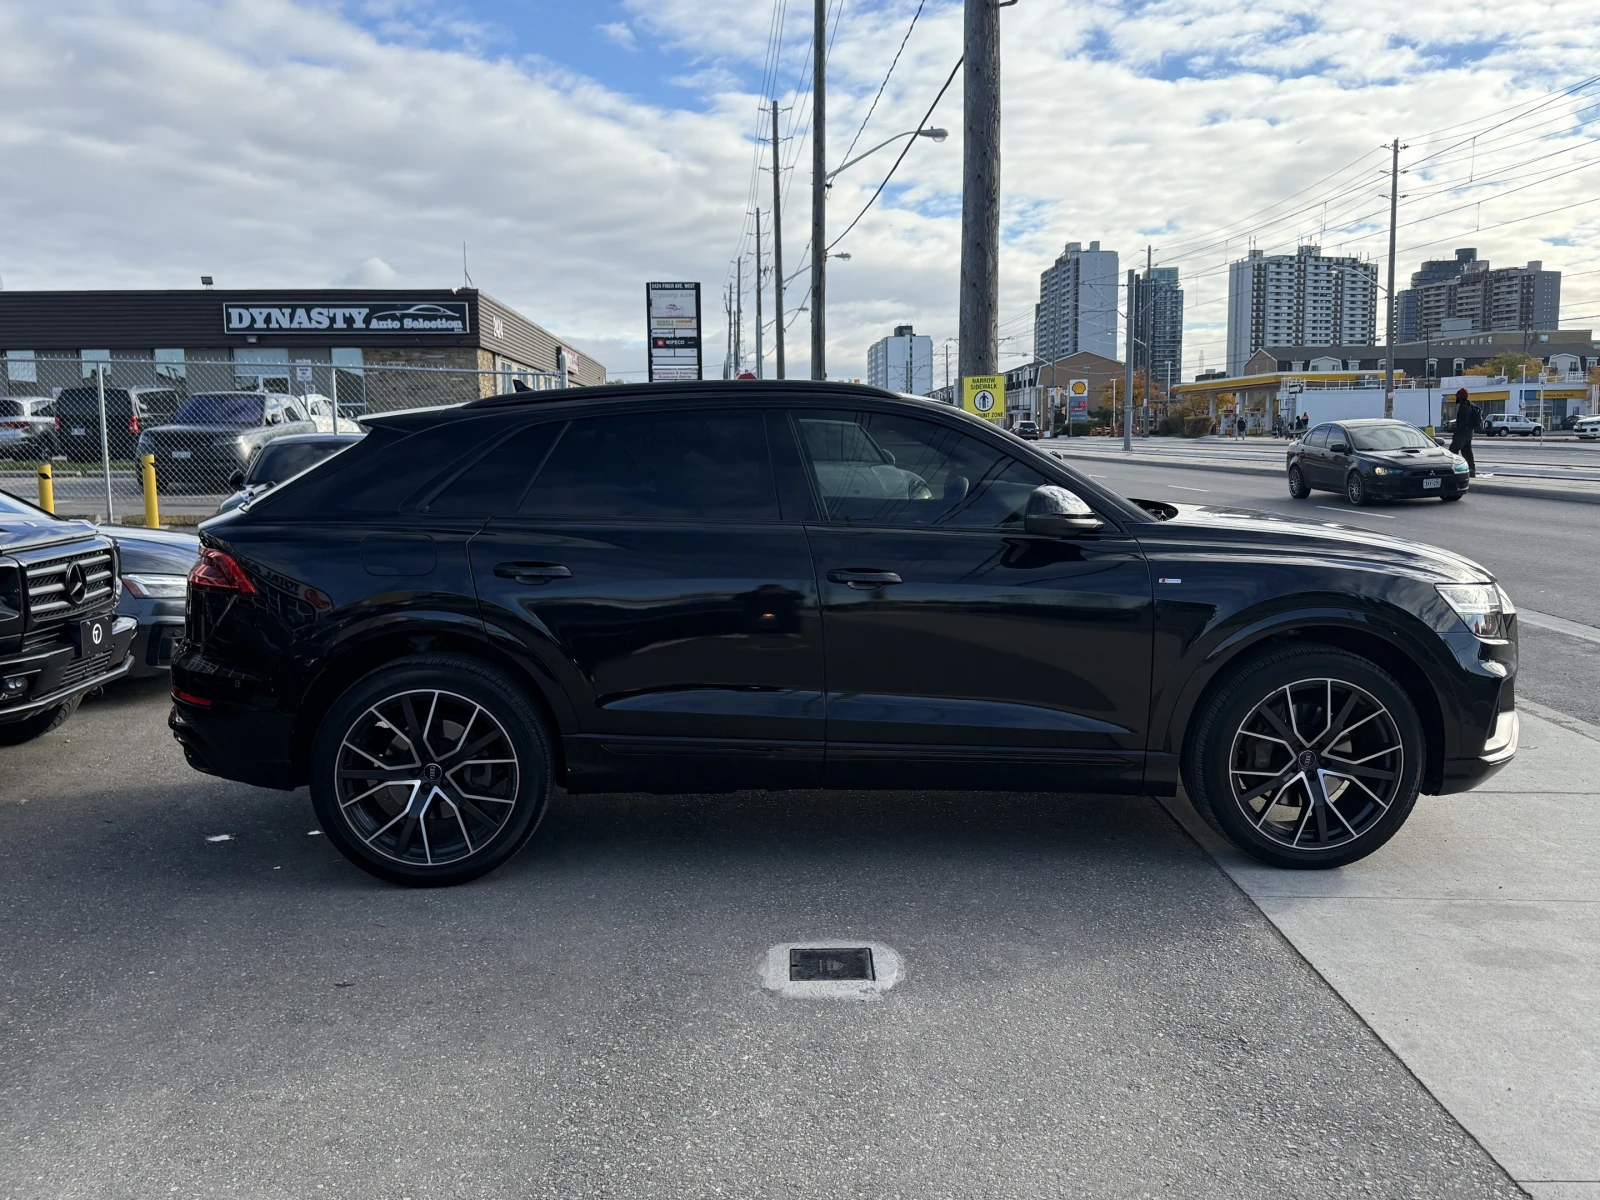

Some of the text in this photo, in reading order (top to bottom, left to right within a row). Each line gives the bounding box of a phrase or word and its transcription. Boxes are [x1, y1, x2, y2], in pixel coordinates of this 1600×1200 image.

[228, 307, 463, 329] DYNASTY Auto Selection
